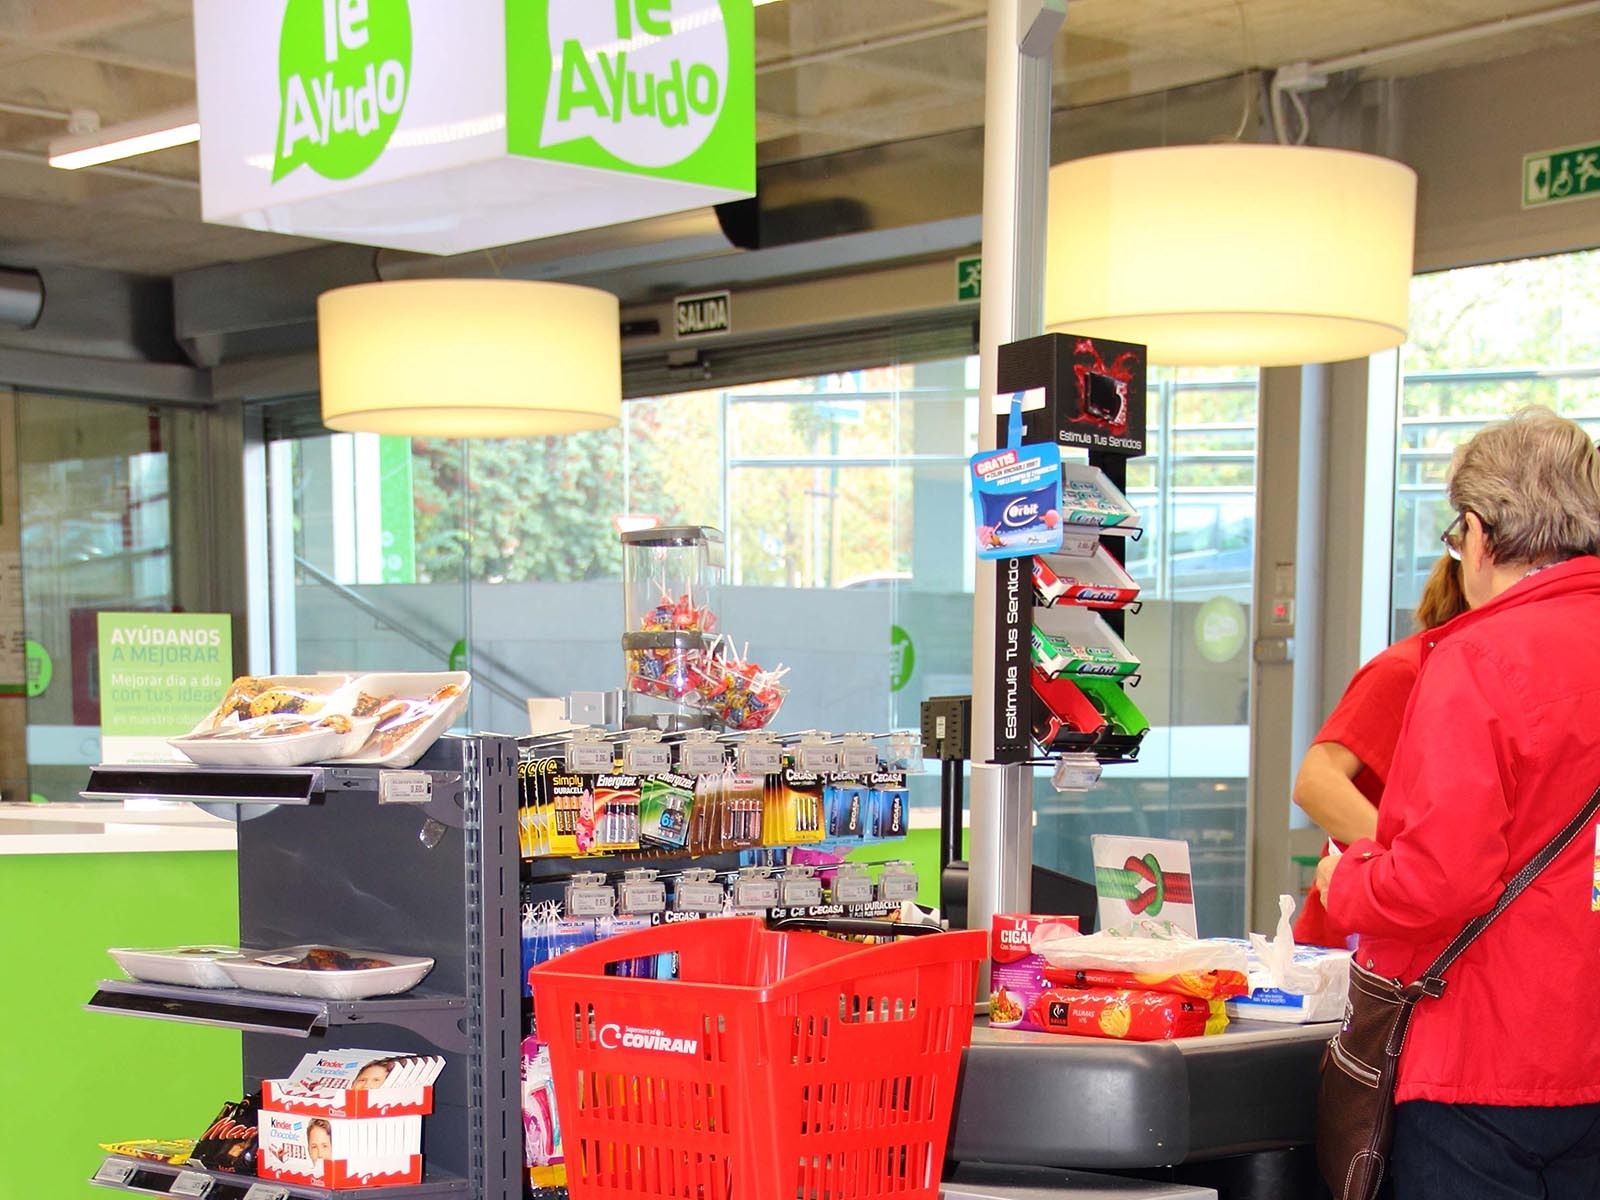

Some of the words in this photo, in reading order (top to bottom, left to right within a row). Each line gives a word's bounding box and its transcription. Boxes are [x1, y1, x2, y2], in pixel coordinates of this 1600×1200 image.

[557, 39, 719, 128] Ayudo
[282, 59, 406, 158] Ayudo
[679, 300, 728, 334] SALIDA
[1059, 430, 1092, 444] Estimula
[1093, 434, 1108, 446] Tus
[1108, 437, 1142, 450] Sentidos
[976, 452, 1016, 475] GRATIS
[1007, 558, 1019, 624] Sentido
[111, 625, 221, 646] AYÚDANOS
[1006, 628, 1018, 662] Tus
[112, 647, 125, 663] A
[131, 647, 220, 666] MEJORAR
[111, 674, 162, 689] Mejorar
[112, 688, 141, 701] con
[145, 688, 171, 701] tus
[179, 687, 222, 701] ideas
[1005, 666, 1018, 739] Estimula
[552, 774, 584, 787] simply
[665, 910, 700, 923] CEGASA
[809, 904, 844, 917] CEGASA
[1015, 920, 1028, 931] LA
[622, 1033, 698, 1055] COVIRAN
